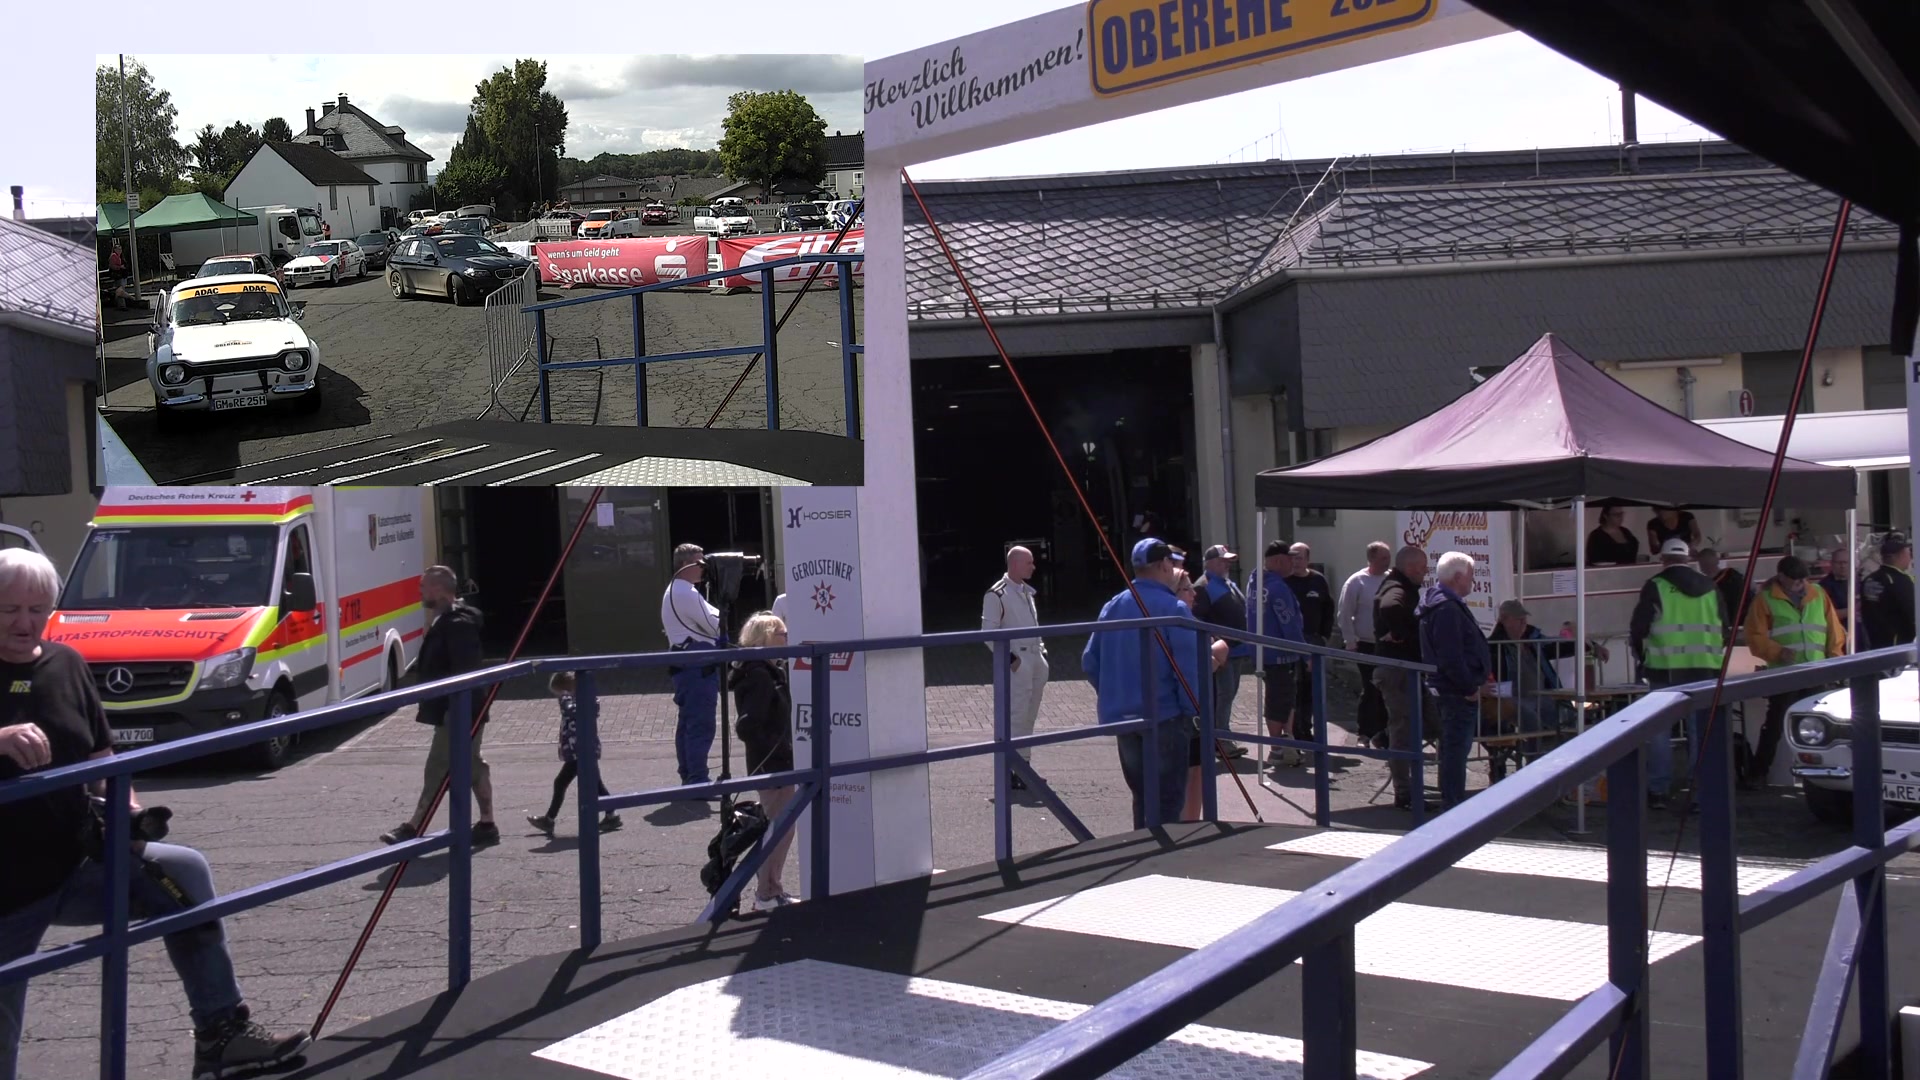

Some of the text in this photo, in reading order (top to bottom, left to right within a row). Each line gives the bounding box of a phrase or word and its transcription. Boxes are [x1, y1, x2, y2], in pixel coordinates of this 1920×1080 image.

[1101, 0, 1292, 75] OBEREHE
[864, 46, 966, 114] Herzlich
[911, 28, 1083, 129] Willkommen!
[572, 250, 583, 258] um
[584, 247, 600, 257] Geld
[602, 247, 619, 259] geht
[549, 262, 644, 284] Sparkasse
[195, 288, 219, 297] ADAC
[803, 510, 852, 520] HOOSIER
[1454, 535, 1489, 546] Fleischerei
[792, 559, 853, 581] GEROLSTEINER
[134, 729, 153, 740] 700
